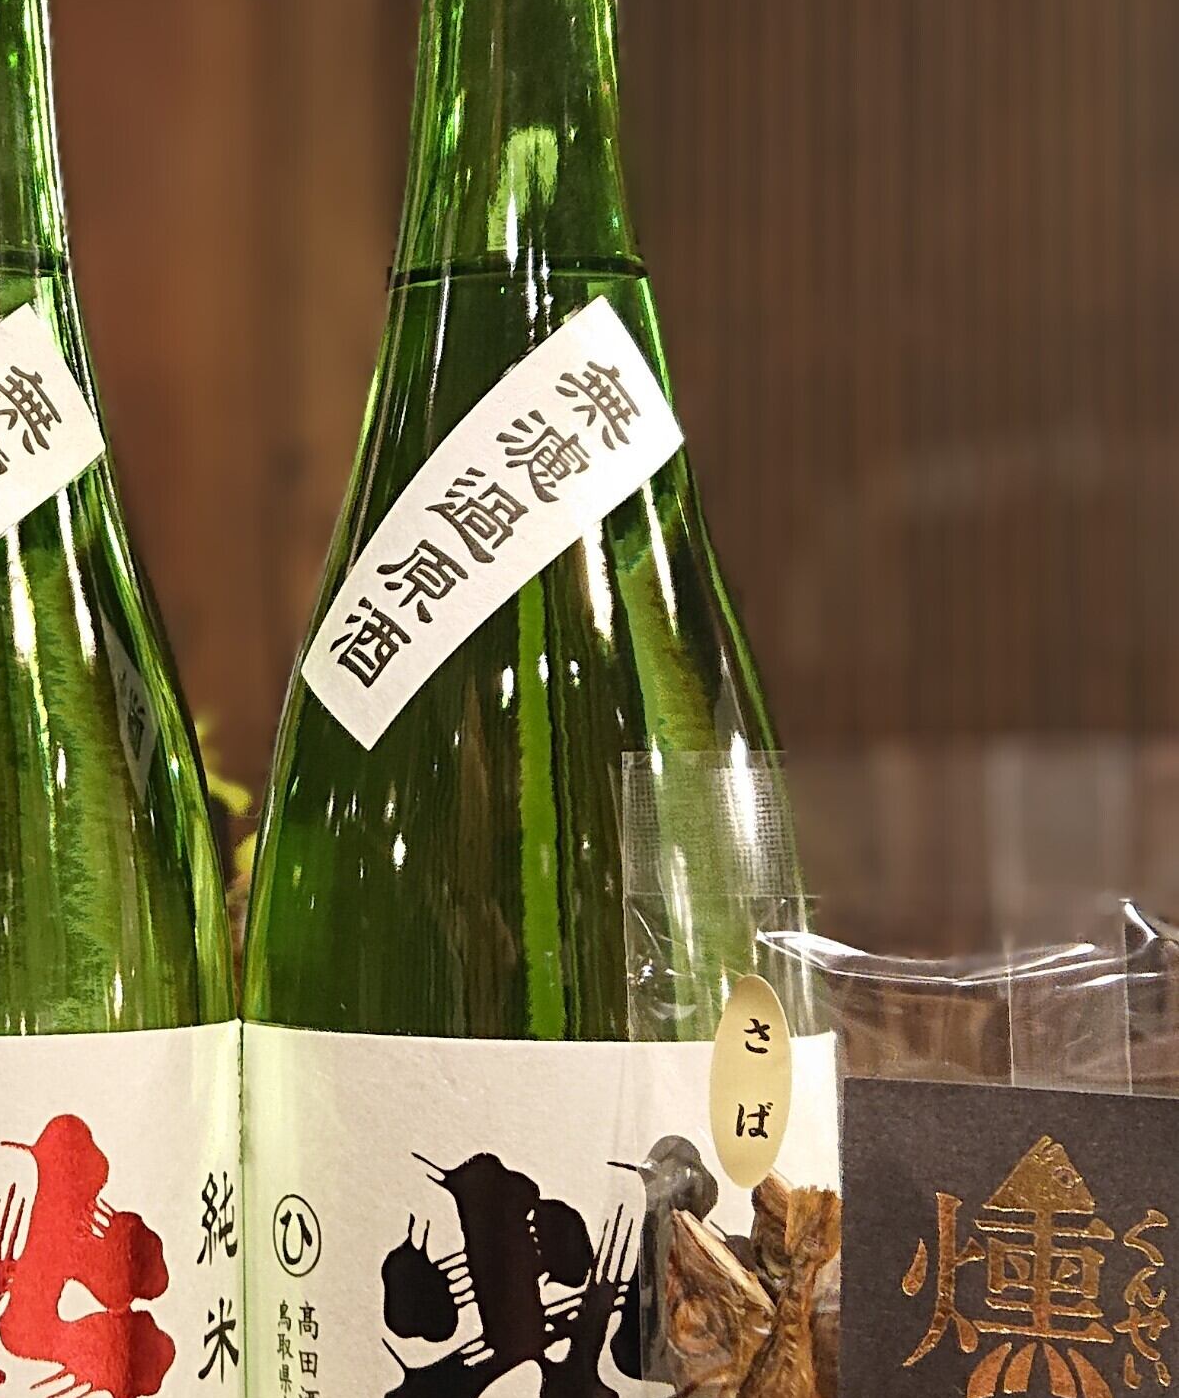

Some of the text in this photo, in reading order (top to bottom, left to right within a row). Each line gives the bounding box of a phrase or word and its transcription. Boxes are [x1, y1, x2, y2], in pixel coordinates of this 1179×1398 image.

[329, 359, 642, 689] 無濾過原酒
[735, 1018, 774, 1140] さば
[1112, 1208, 1172, 1390] くんせい
